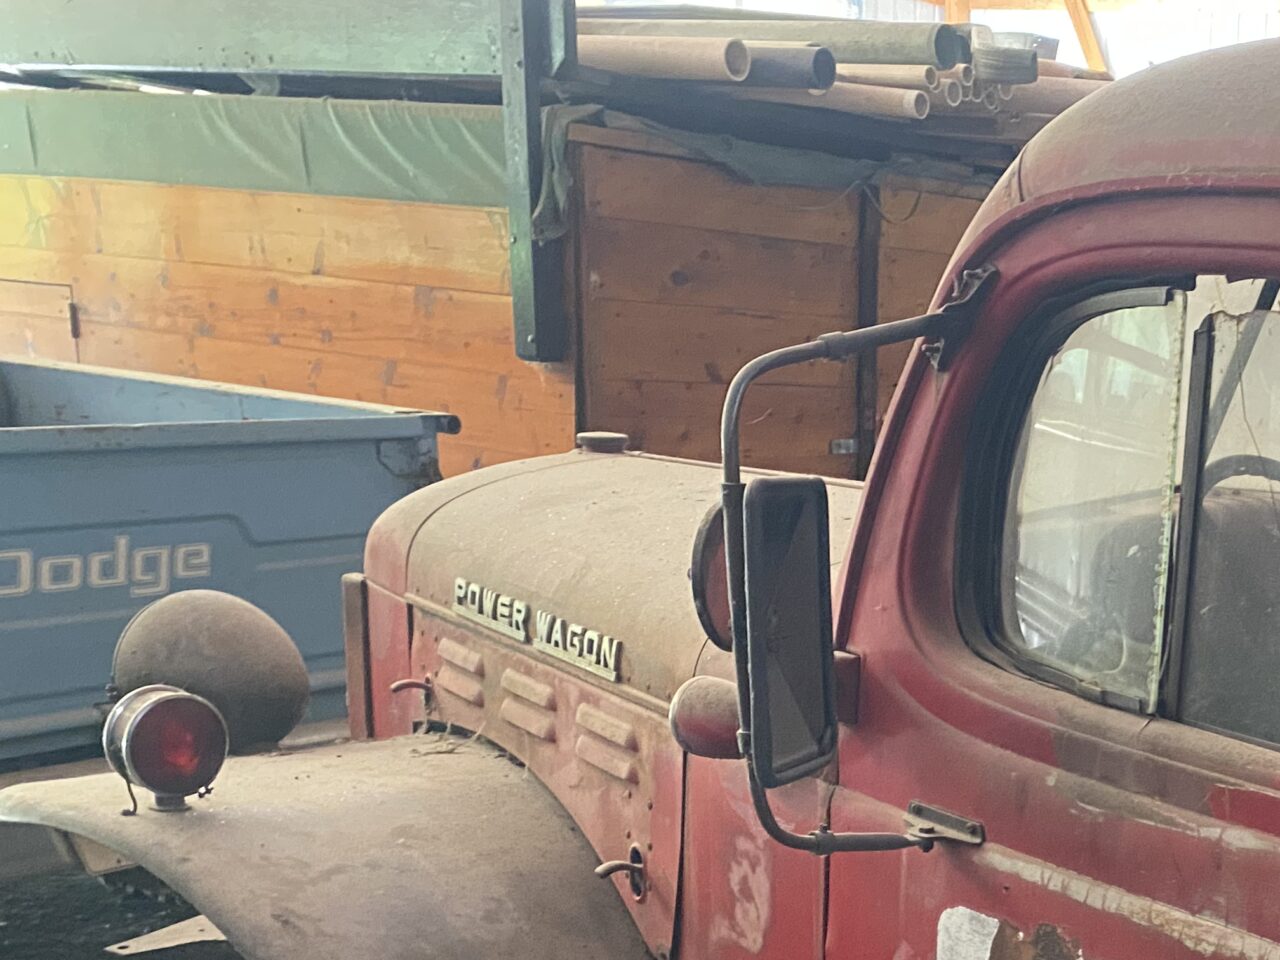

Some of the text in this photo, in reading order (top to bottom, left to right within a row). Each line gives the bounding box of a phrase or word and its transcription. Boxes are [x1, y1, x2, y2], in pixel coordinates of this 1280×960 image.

[0, 534, 210, 597] Dodge
[454, 576, 622, 674] POWER WAGON
